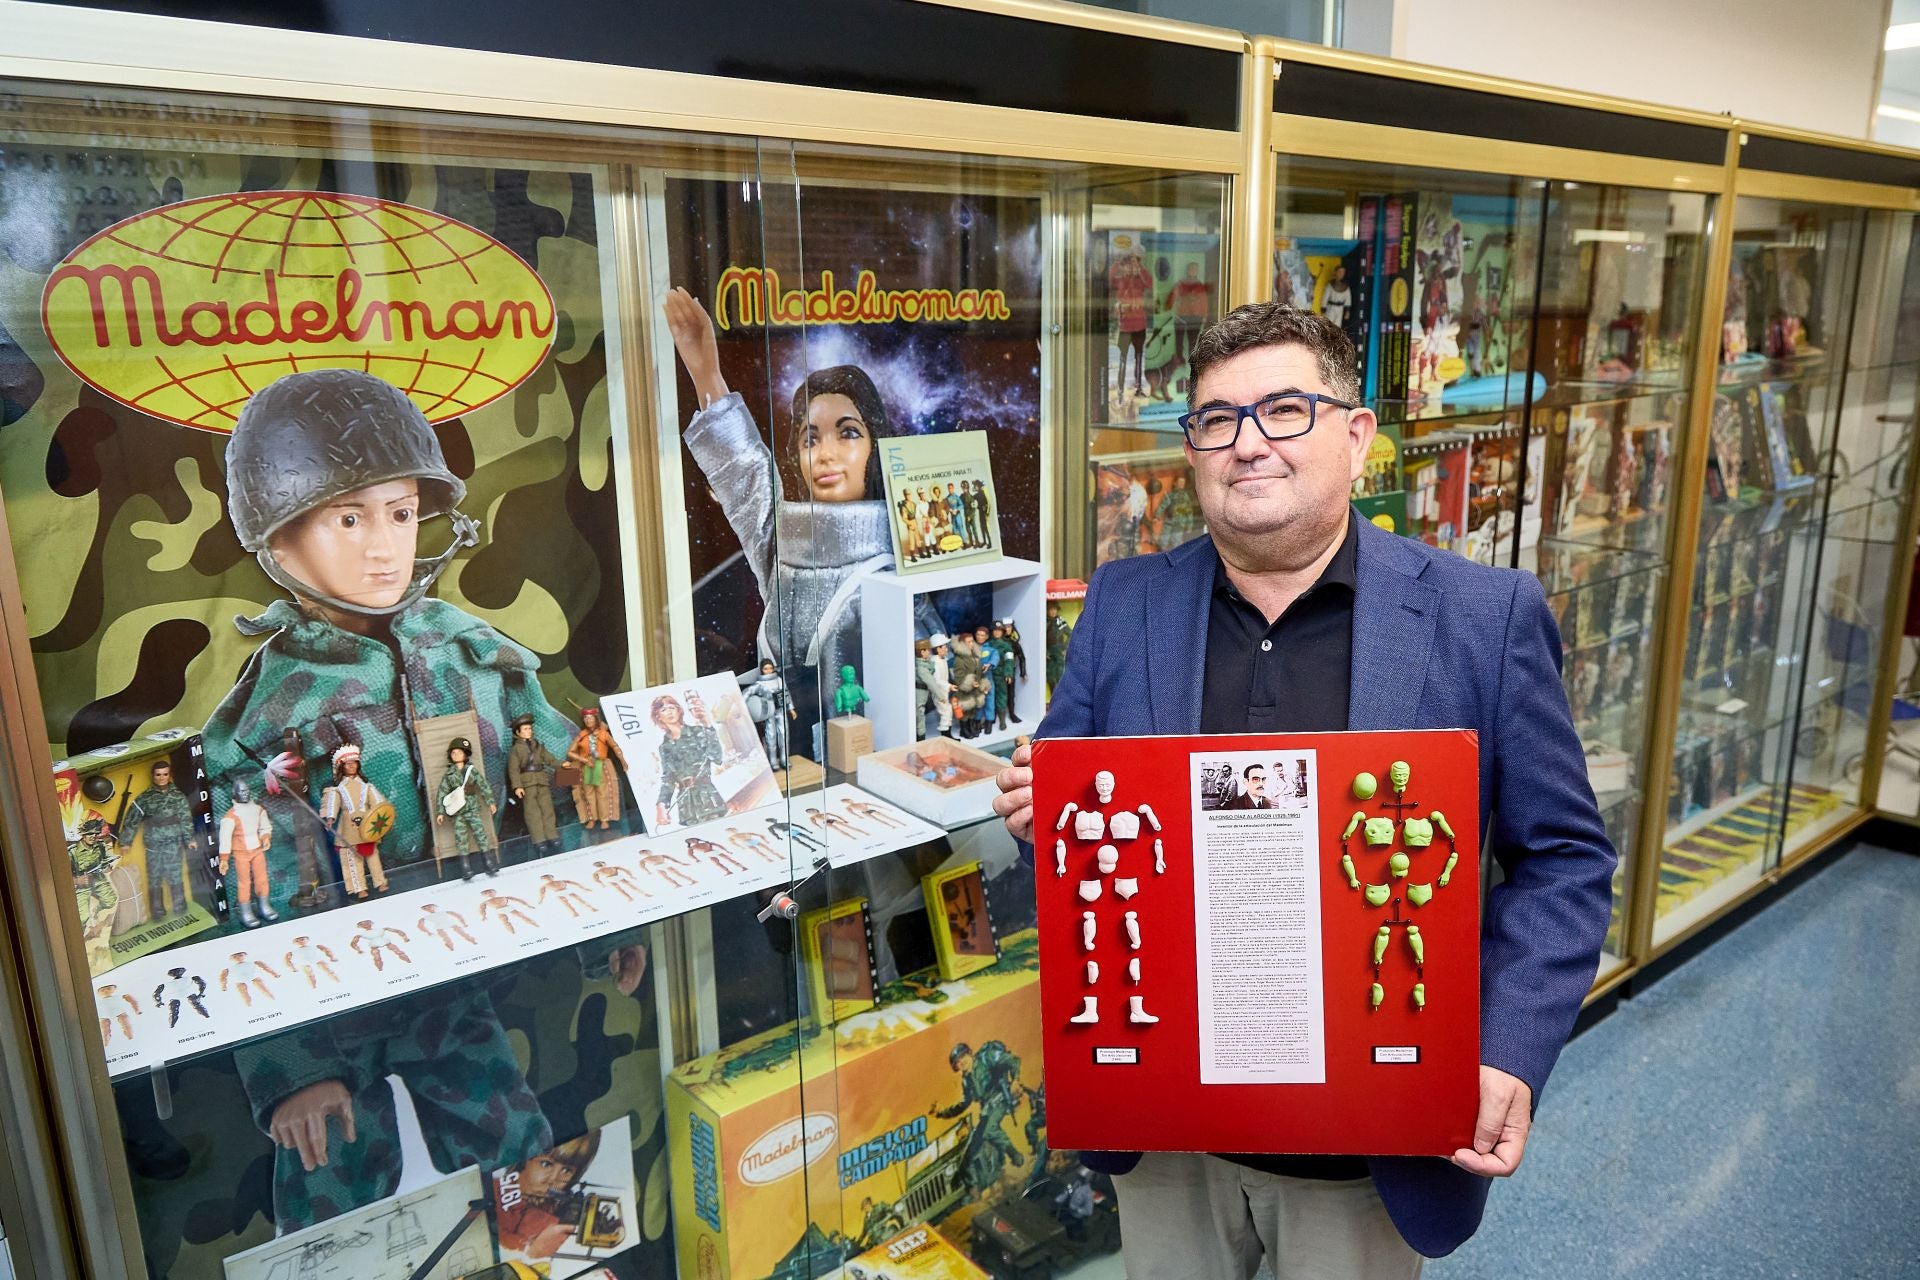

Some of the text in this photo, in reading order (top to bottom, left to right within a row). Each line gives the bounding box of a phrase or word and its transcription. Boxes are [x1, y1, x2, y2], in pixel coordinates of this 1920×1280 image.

[45, 264, 552, 348] Madelman
[716, 266, 1010, 330] Madelwoman
[888, 447, 906, 480] 1971
[931, 470, 951, 480] AMIGOS
[1046, 590, 1087, 600] ADELMAN
[615, 704, 643, 740] 1977
[111, 913, 200, 955] EQUIPO INDIVIDUAL
[743, 1125, 836, 1172] Madelman
[500, 1171, 522, 1213] 1975
[887, 1229, 927, 1259] JEEP
